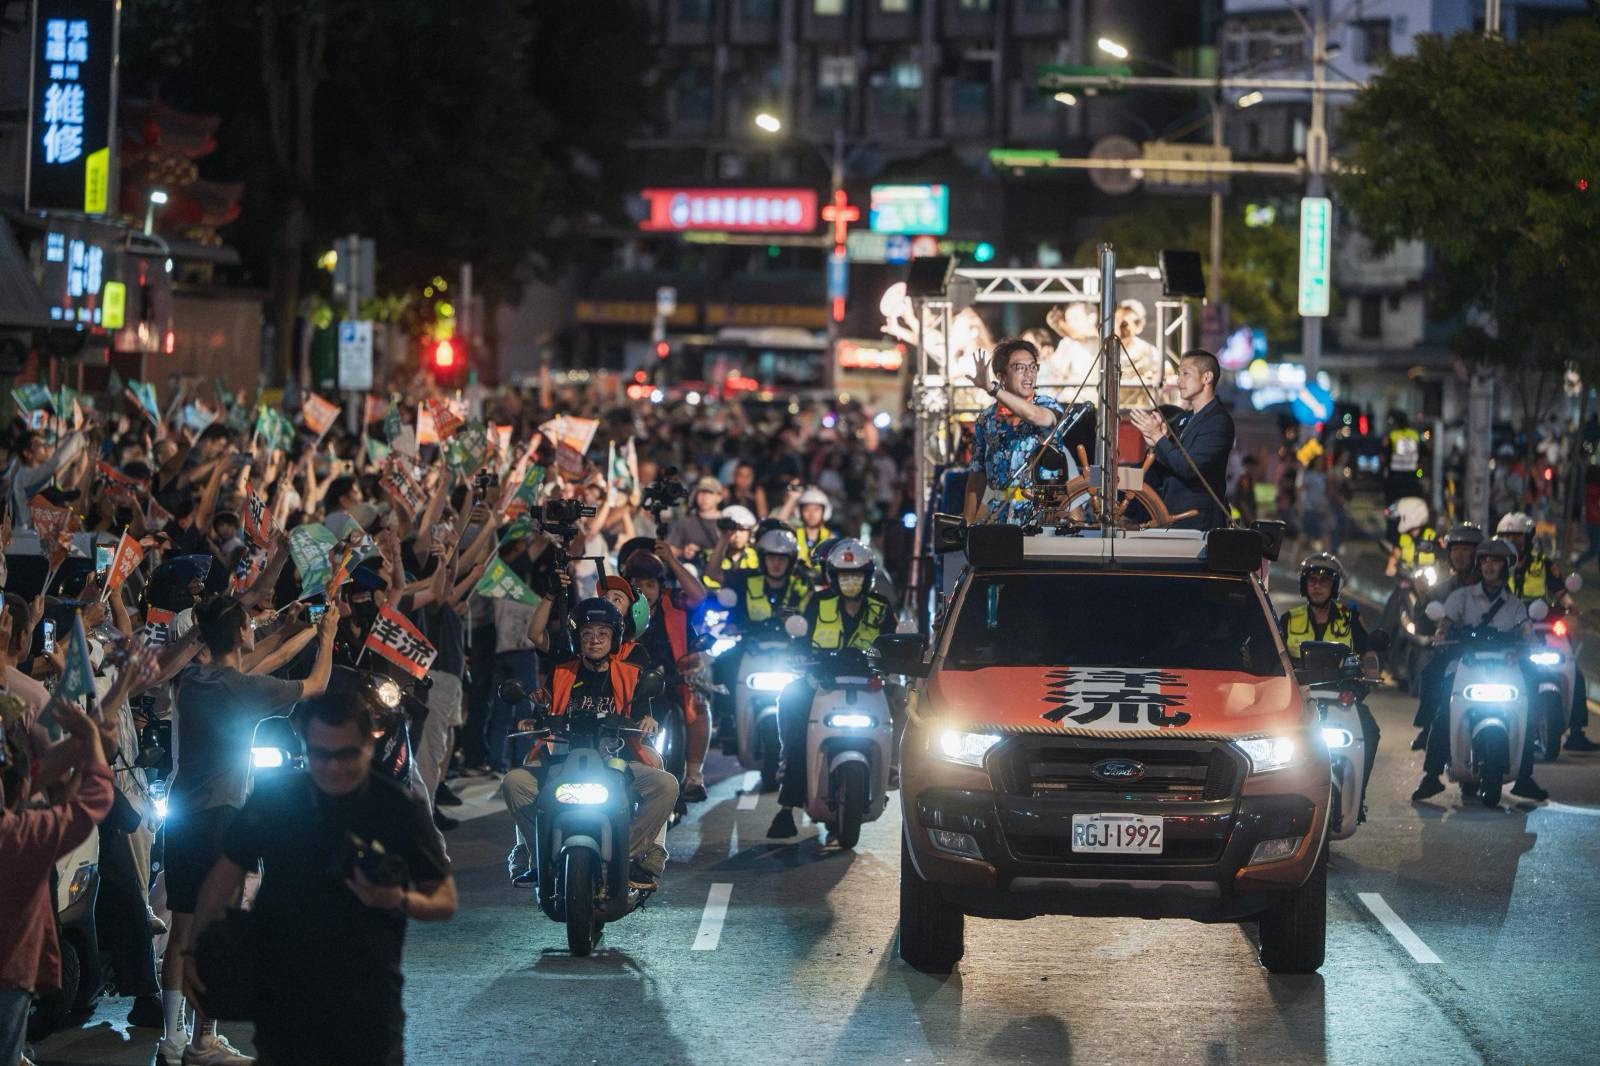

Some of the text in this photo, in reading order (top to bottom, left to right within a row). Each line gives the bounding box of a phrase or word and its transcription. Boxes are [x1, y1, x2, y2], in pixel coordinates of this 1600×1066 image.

[44, 83, 84, 163] 維修
[371, 615, 434, 667] 洋流
[1041, 670, 1192, 728] 洋流
[1103, 763, 1134, 776] Ford
